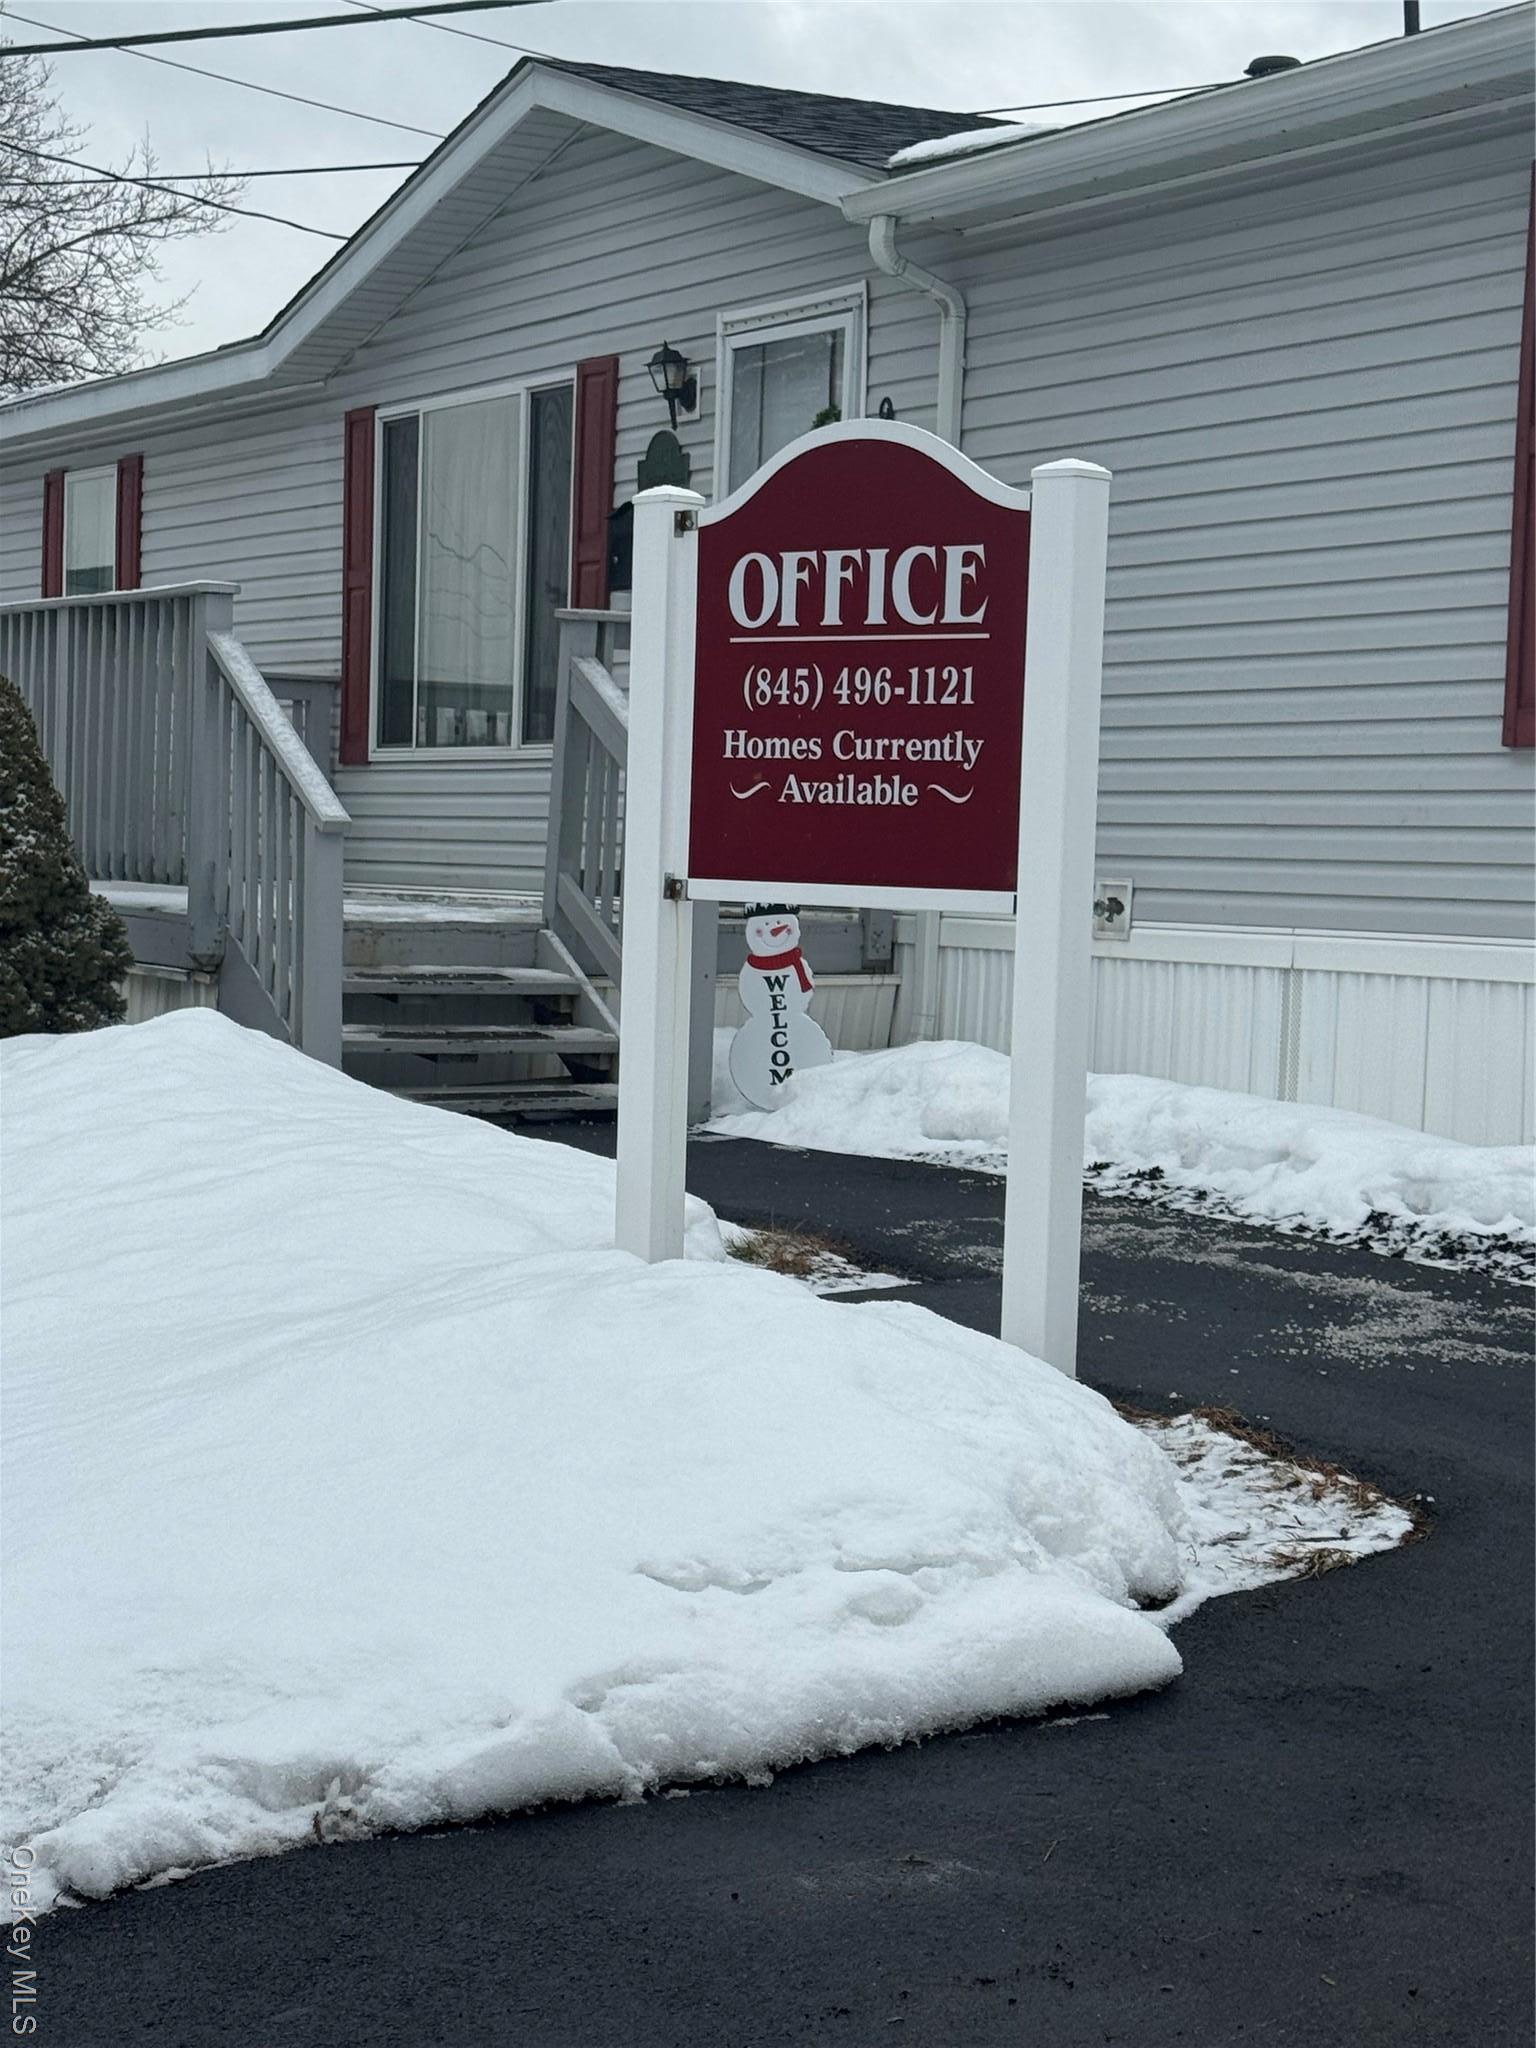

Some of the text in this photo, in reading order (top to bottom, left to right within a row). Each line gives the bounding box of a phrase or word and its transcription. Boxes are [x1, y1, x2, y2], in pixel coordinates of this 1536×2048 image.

[729, 544, 987, 628] OFFICE
[744, 664, 974, 711] (845) 496-1121
[723, 730, 984, 770] Homes Currently
[779, 774, 918, 806] Available
